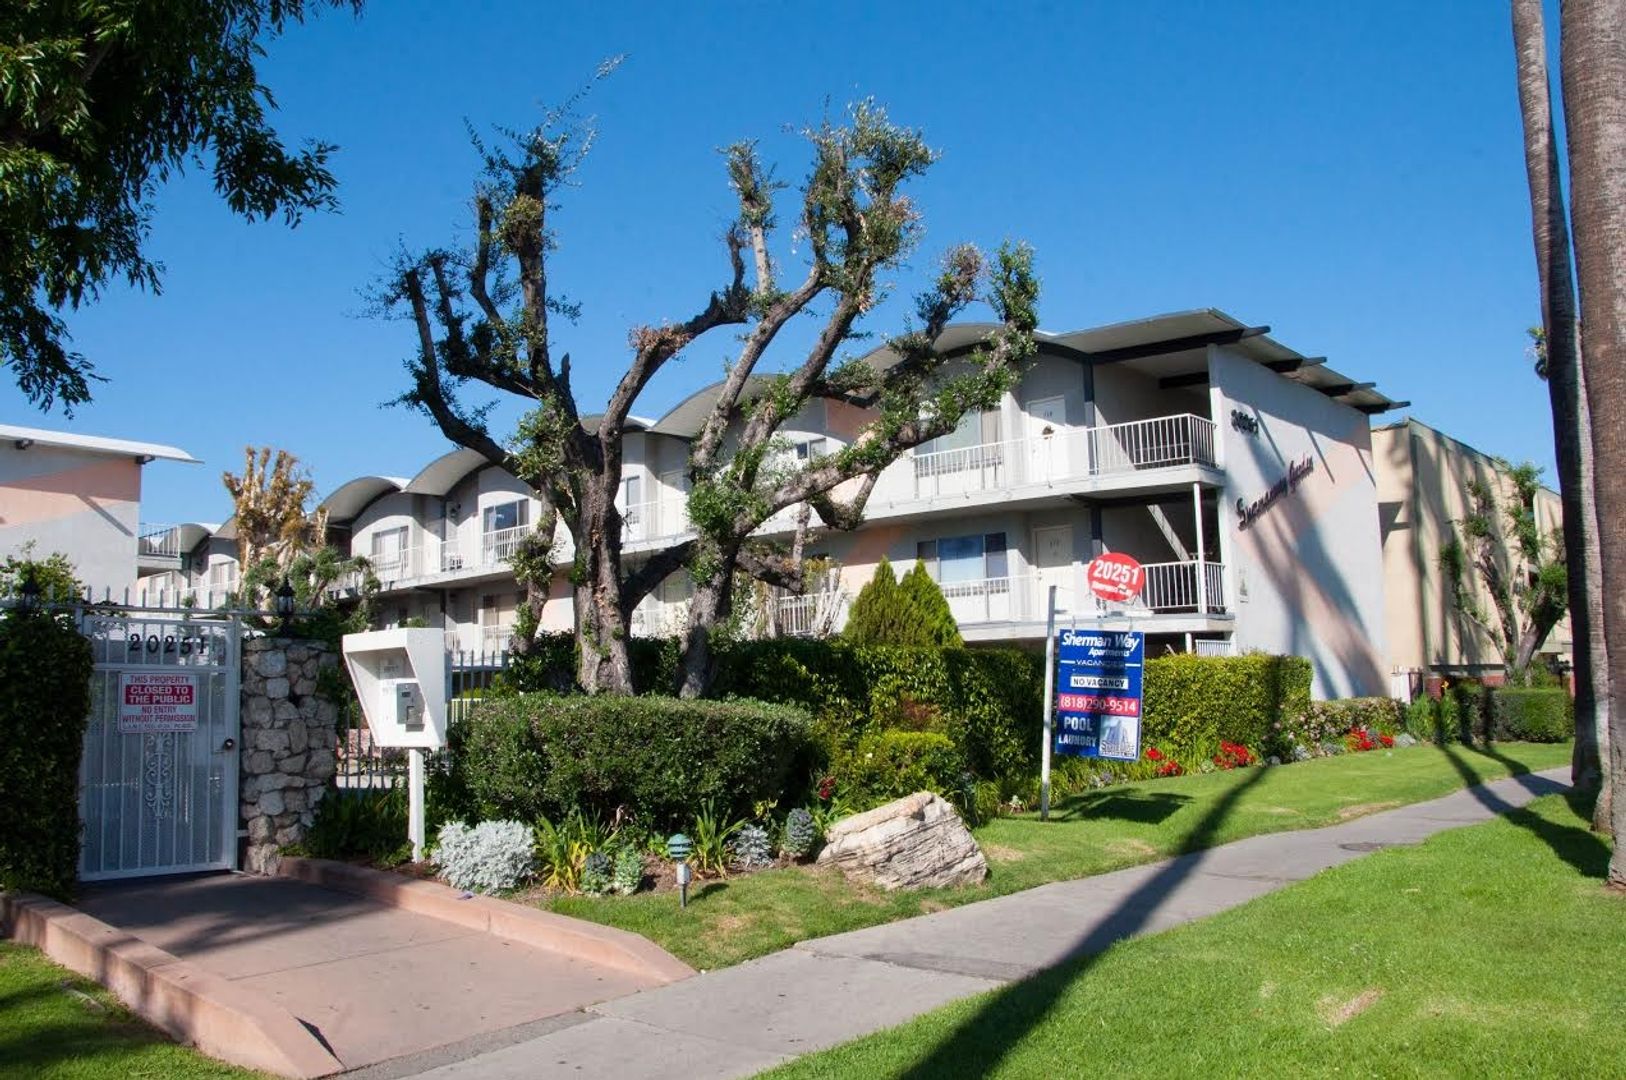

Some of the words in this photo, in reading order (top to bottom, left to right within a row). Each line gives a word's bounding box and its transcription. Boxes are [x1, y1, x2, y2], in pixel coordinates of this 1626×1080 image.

[1092, 559, 1139, 585] 20251
[129, 633, 205, 655] 20251
[1062, 631, 1112, 647] Sherman
[1114, 633, 1140, 652] Way
[130, 675, 147, 684] THIS
[148, 675, 189, 684] PROPERTY
[1073, 678, 1086, 686] NO
[1087, 678, 1125, 688] VACANCY
[129, 686, 173, 694] CLOSED
[175, 686, 189, 694] TO
[128, 695, 151, 704] THE
[152, 695, 191, 704] PUBLIC
[1060, 695, 1136, 713] (818)290-9514
[141, 706, 151, 714] NO
[153, 706, 177, 714] ENTRY
[121, 714, 153, 723] WITHOUT
[154, 714, 195, 722] PERMISSION
[1063, 716, 1093, 732] POOL
[1058, 734, 1097, 748] LAUNDRY
